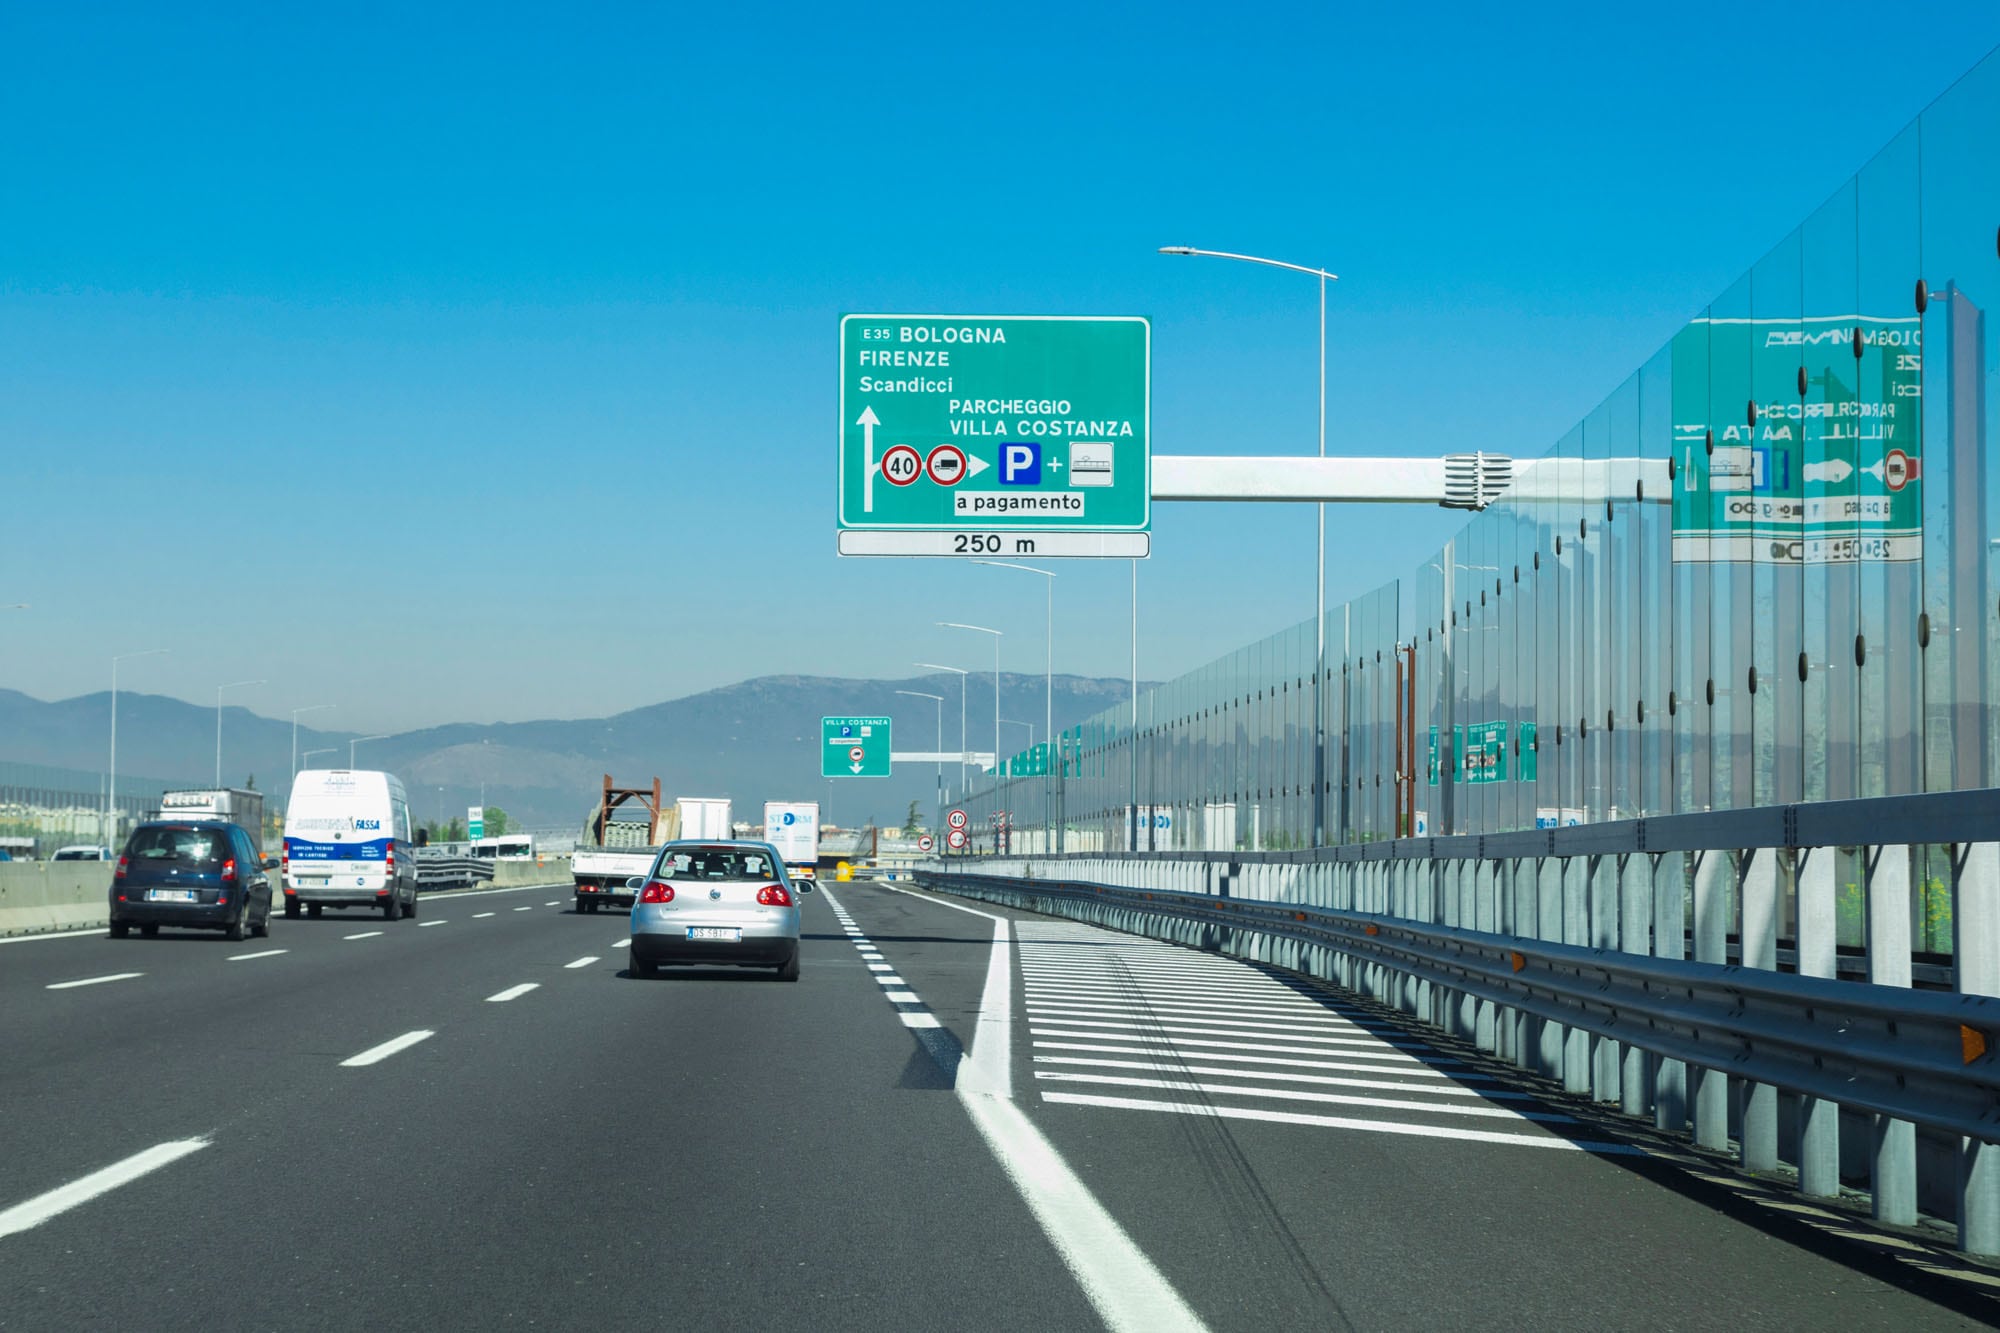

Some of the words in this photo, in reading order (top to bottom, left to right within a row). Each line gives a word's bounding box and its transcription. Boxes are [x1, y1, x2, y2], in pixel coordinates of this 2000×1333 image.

[900, 327, 1006, 343] BOLOGNA
[860, 351, 950, 367] FIRENZE
[859, 376, 953, 393] Scandicci
[949, 399, 1071, 415] PARCHEGGIO
[950, 420, 1008, 436] VILLA
[1017, 421, 1133, 437] COSTANZA
[889, 455, 915, 475] 40
[1006, 445, 1034, 481] P
[957, 498, 967, 509] a
[974, 495, 1081, 513] pagamento
[954, 535, 1002, 553] 250
[1016, 539, 1035, 553] m
[355, 819, 380, 830] FASSA
[769, 812, 813, 826] STORM
[950, 813, 964, 825] 40
